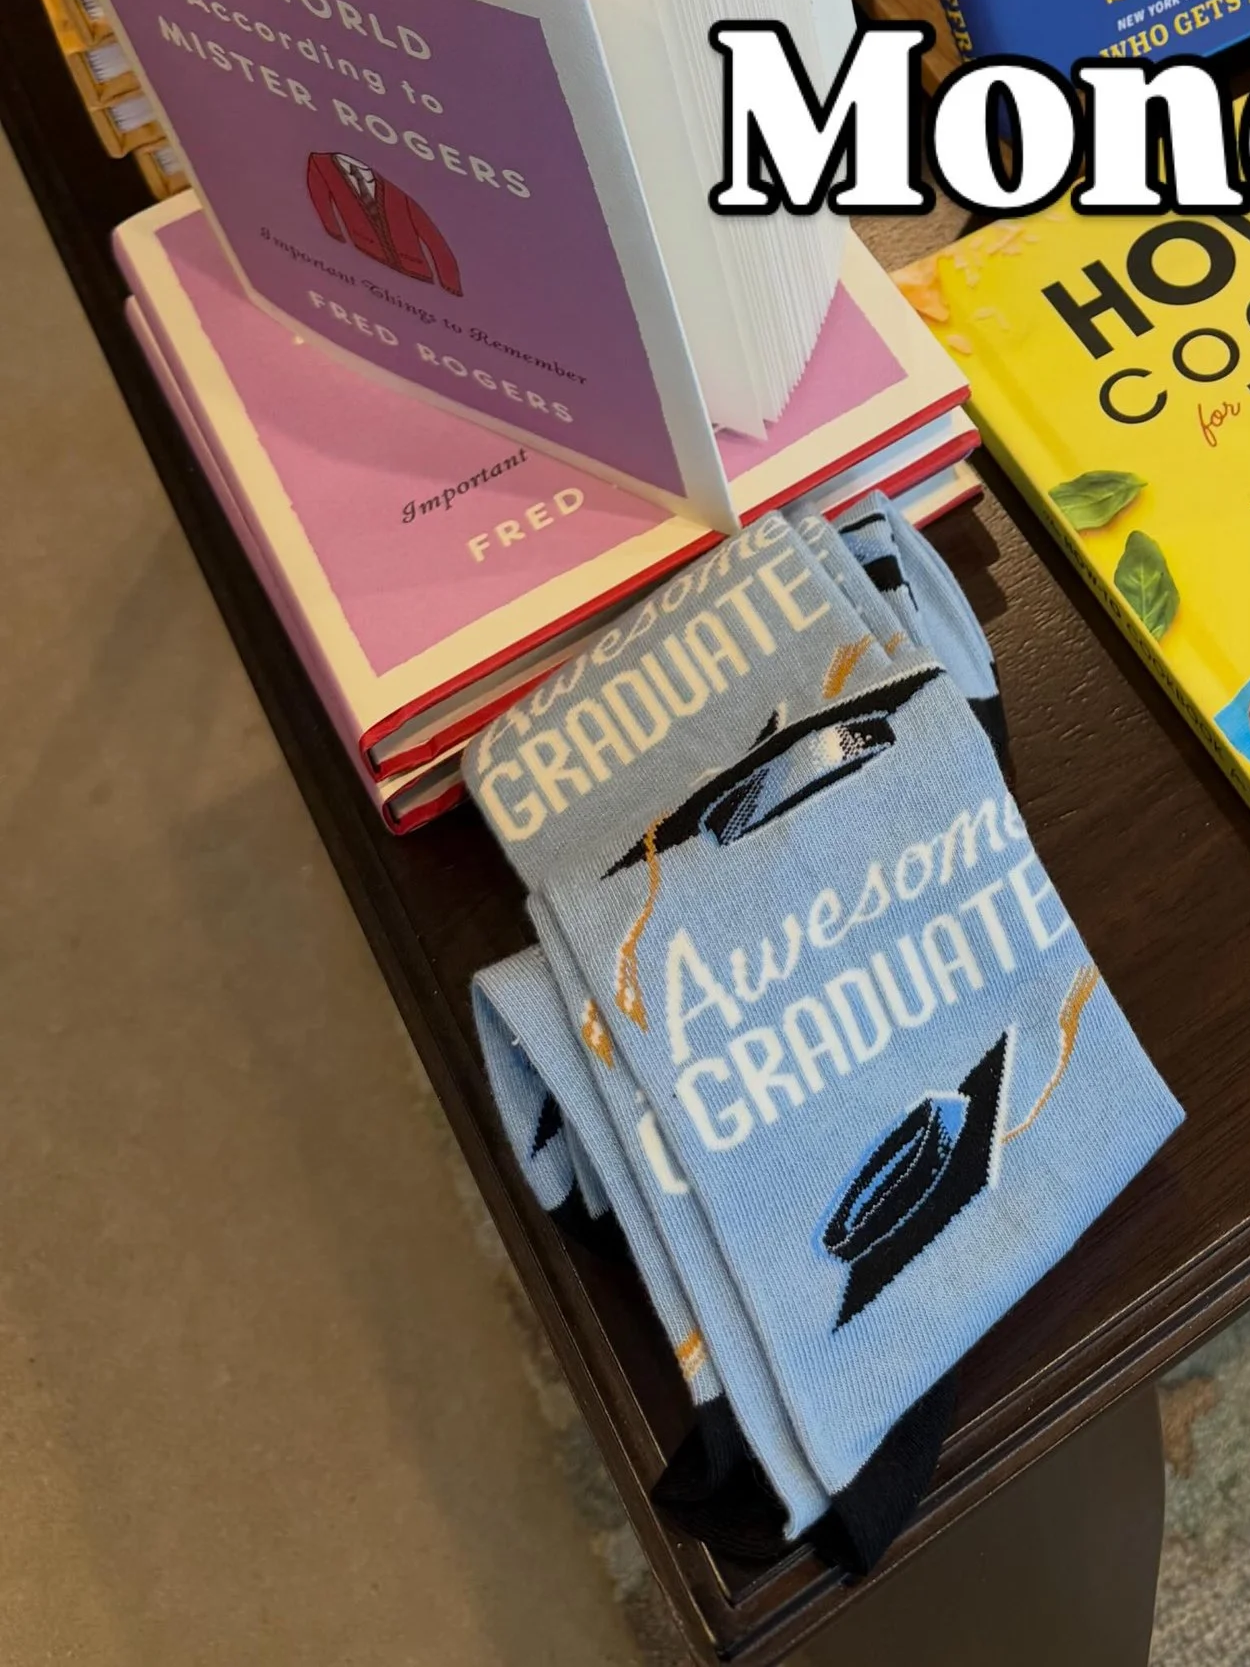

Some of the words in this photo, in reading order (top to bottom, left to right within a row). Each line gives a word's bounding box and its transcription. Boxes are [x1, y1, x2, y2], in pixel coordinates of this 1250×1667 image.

[1099, 23, 1170, 59] WHO
[1117, 8, 1145, 32] NEW
[157, 15, 319, 111] MISTER
[332, 97, 532, 199] ROGERS
[399, 79, 445, 115] to
[259, 226, 358, 285] Important
[361, 277, 438, 325] Things
[441, 315, 463, 334] to
[469, 327, 588, 385] Remember
[307, 290, 399, 346] FRED
[416, 342, 575, 424] ROGERS
[1198, 399, 1242, 448] for
[400, 447, 531, 524] Important
[466, 487, 586, 563] FRED
[480, 550, 833, 845] GRADUATE
[666, 790, 1028, 1066] Awesome
[673, 856, 1073, 1152] GRADUATE
